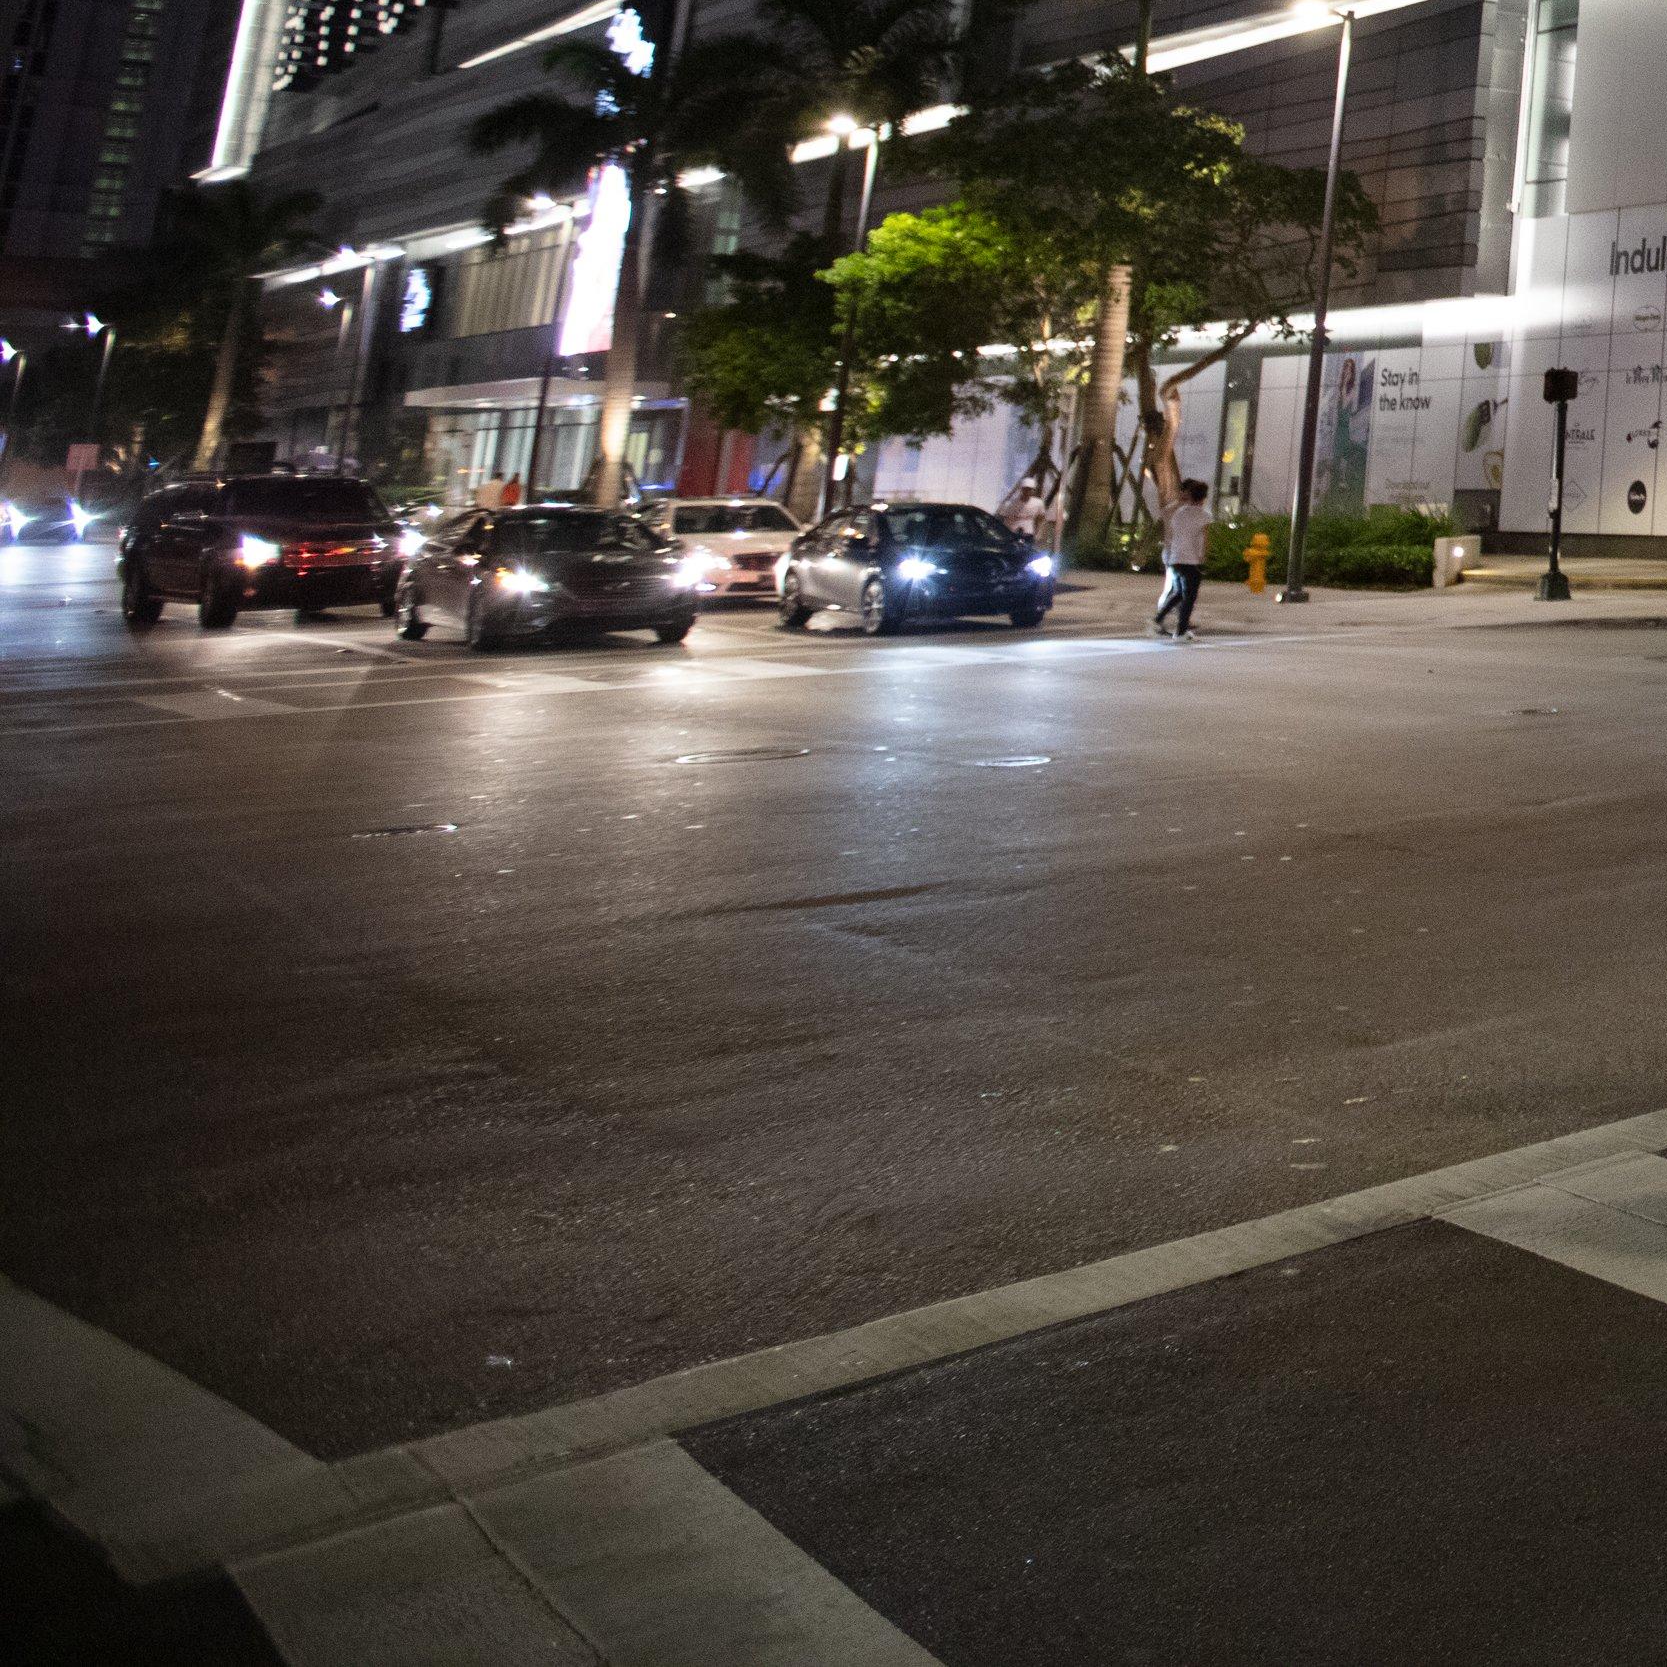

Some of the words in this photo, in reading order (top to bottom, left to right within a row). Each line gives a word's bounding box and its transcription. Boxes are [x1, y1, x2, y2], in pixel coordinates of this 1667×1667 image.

[1380, 368, 1406, 389] Stay
[1408, 367, 1419, 386] in
[1379, 394, 1397, 412] the
[1399, 393, 1432, 411] know
